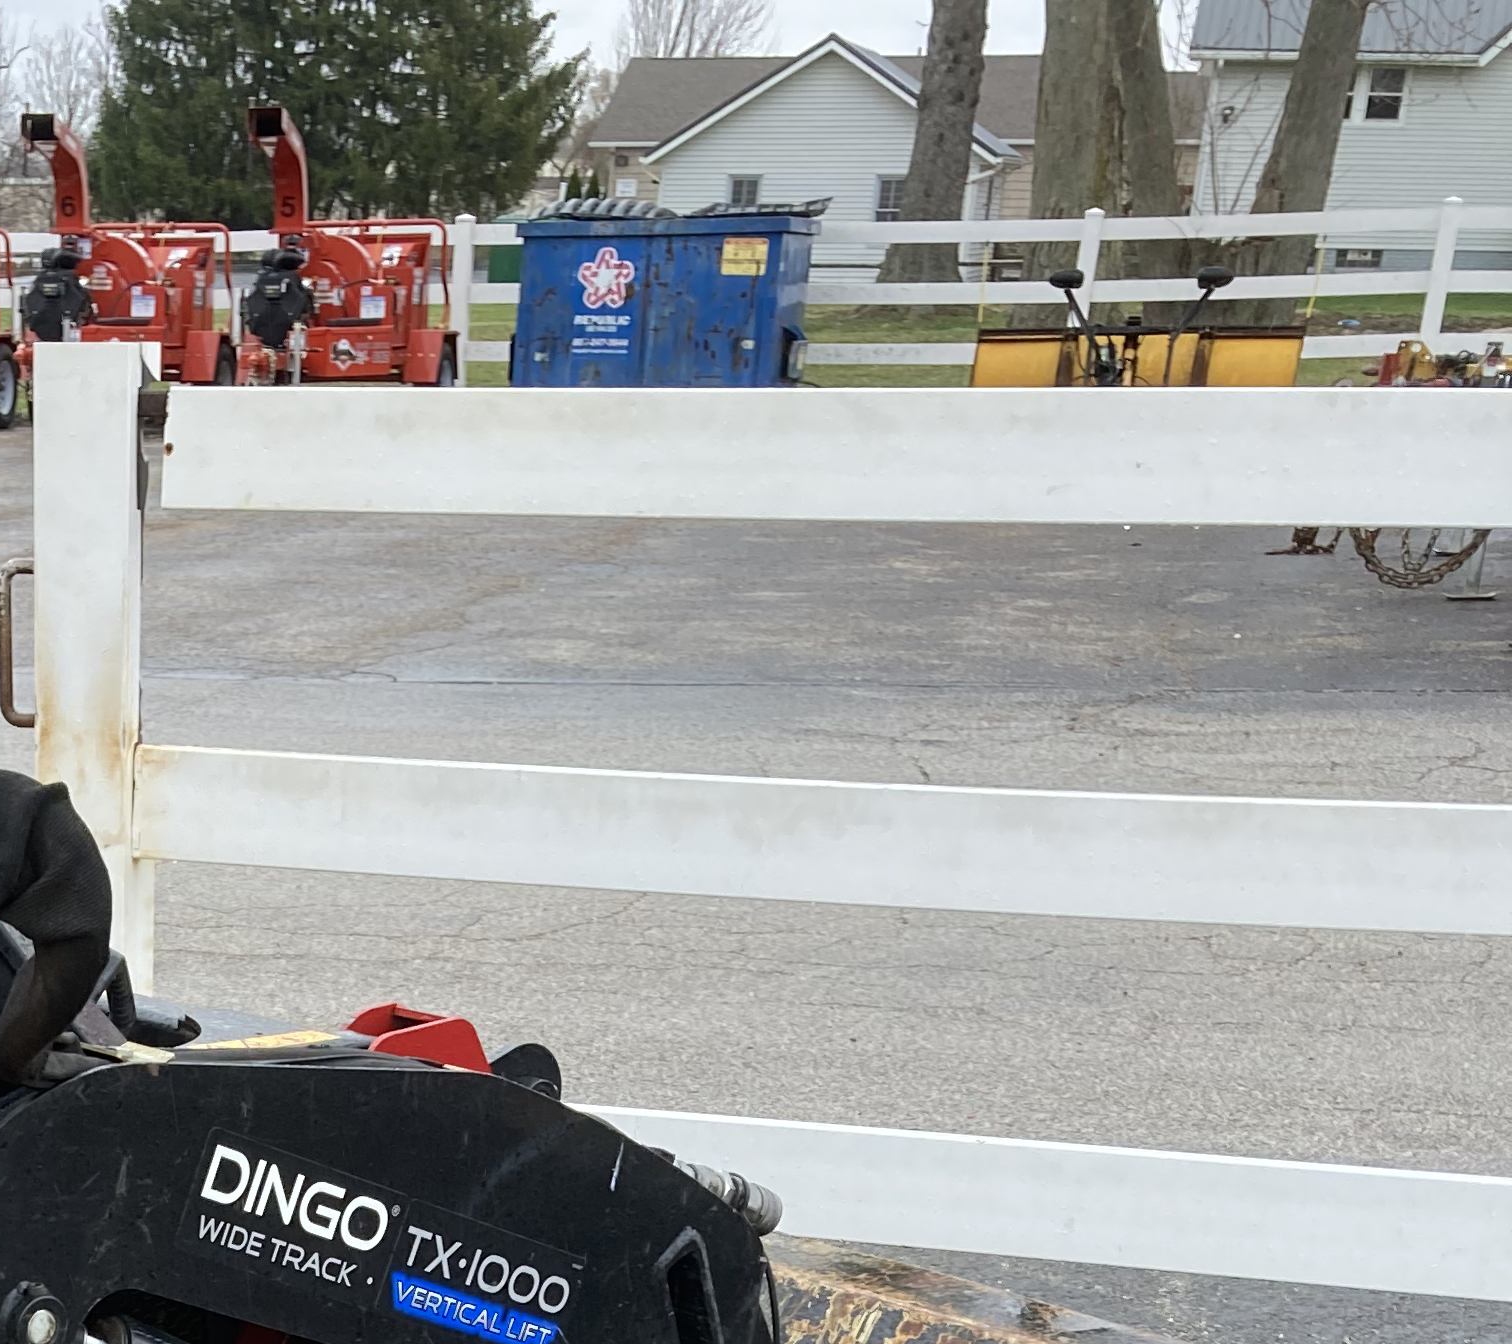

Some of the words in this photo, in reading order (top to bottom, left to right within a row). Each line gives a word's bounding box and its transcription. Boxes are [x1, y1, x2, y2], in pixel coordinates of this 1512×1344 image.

[61, 196, 76, 217] 6
[280, 195, 296, 218] 5
[199, 1215, 266, 1258] WIDE
[271, 1238, 358, 1287] TRACK
[397, 1281, 501, 1334] VERTICAL
